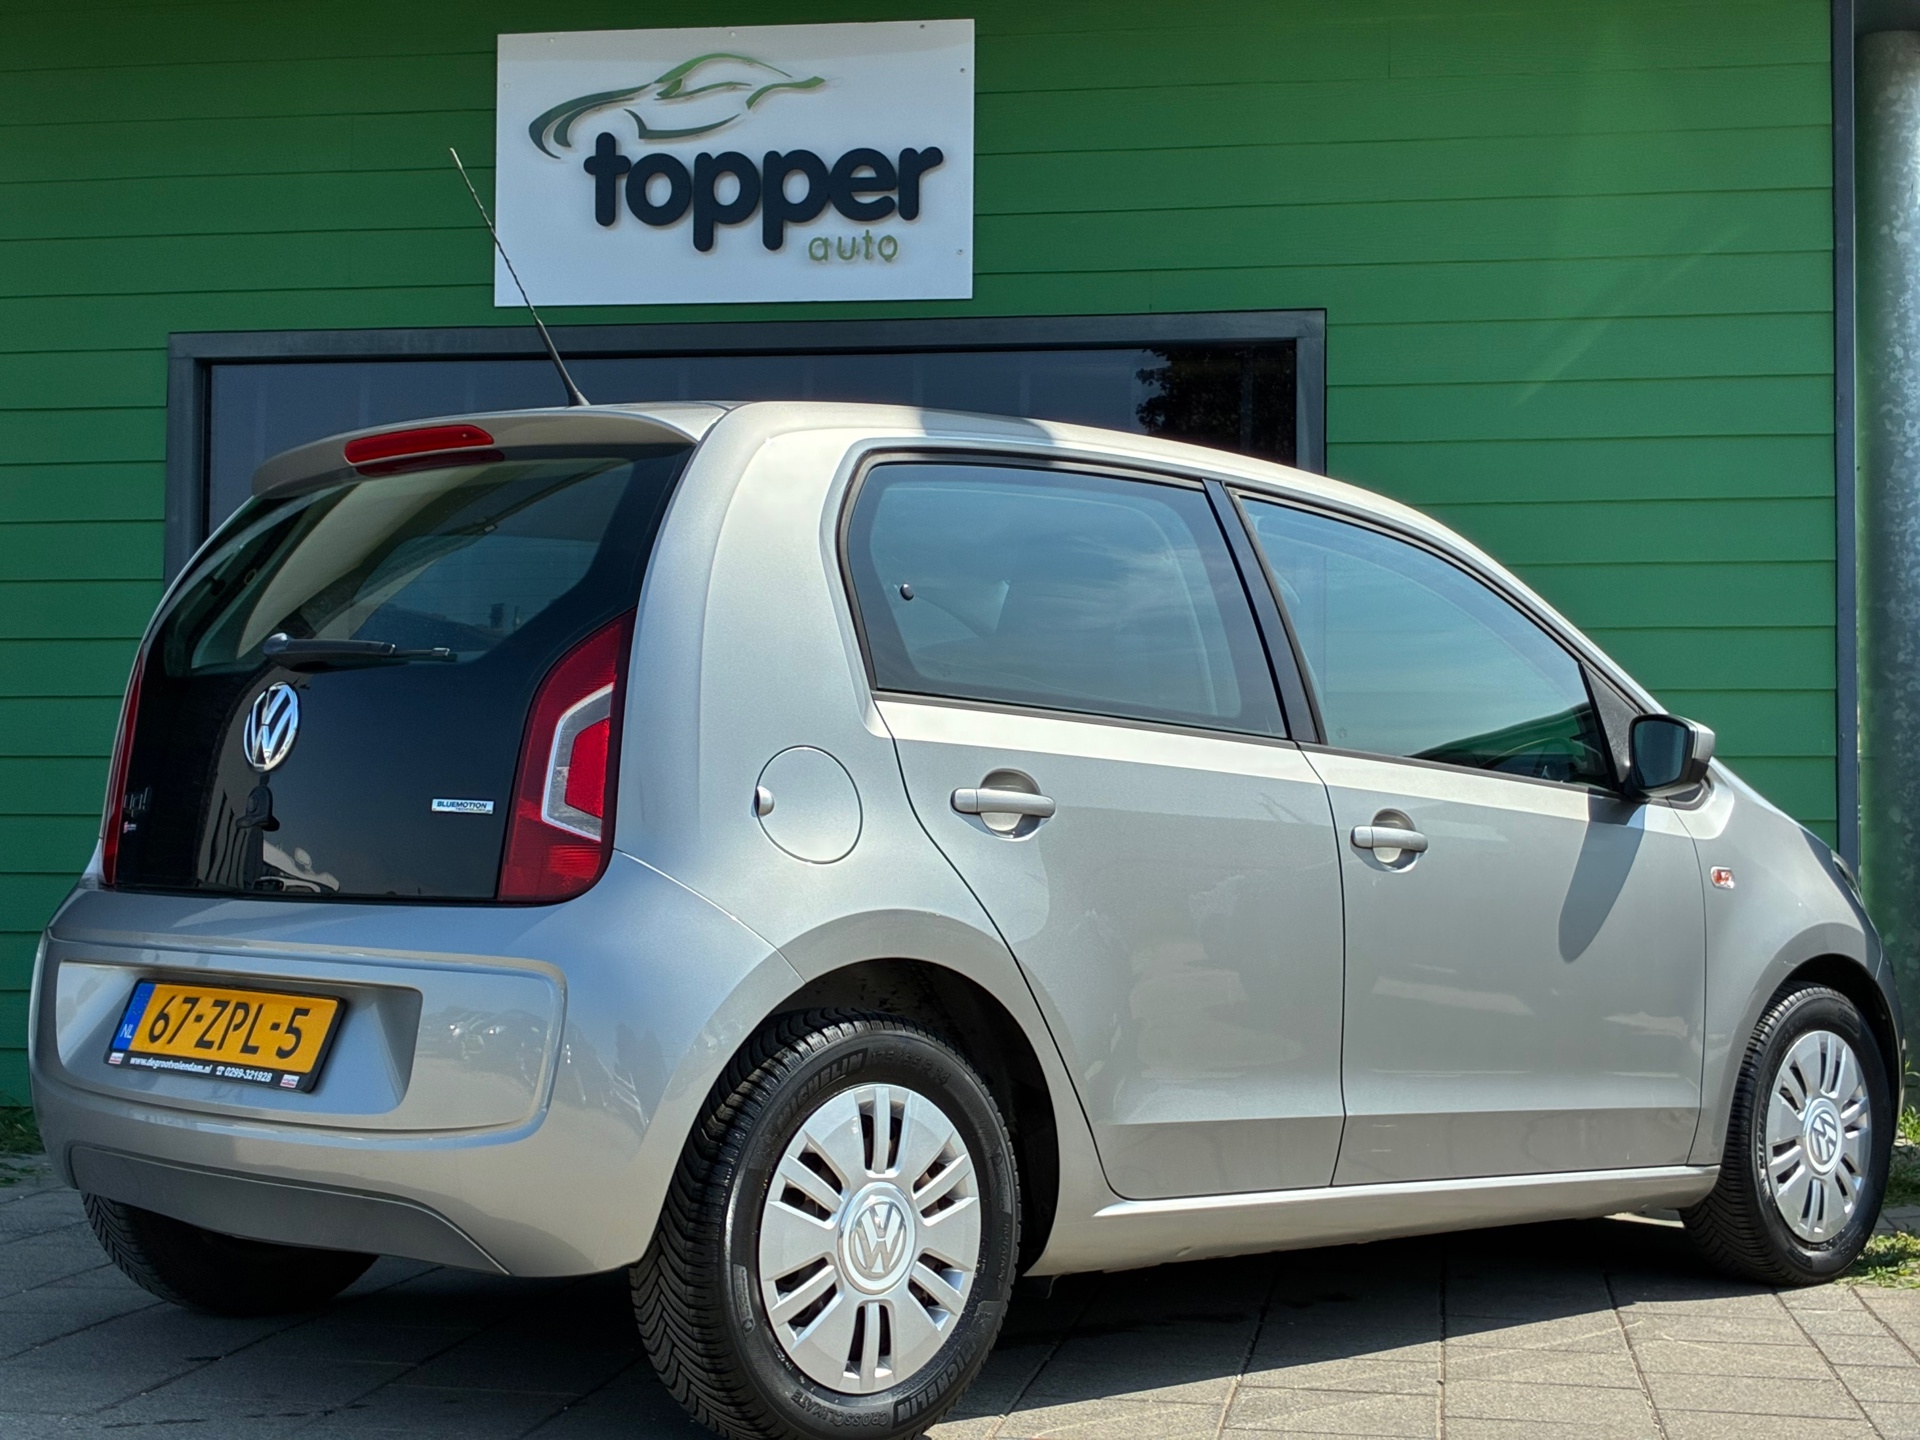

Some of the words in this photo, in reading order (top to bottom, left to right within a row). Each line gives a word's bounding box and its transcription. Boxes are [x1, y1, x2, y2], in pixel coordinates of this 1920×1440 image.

[583, 132, 943, 252] topper
[808, 230, 898, 262] auto
[436, 801, 488, 809] BLUEMOTION
[120, 1024, 132, 1039] NL
[148, 995, 310, 1059] 67-ZPL-5
[130, 1057, 213, 1074] www.degrootvolendam.nl
[224, 1067, 273, 1083] 0299-321928
[776, 1052, 863, 1127] MICHELIN
[897, 1340, 977, 1423] MICHELIN
[791, 1389, 890, 1426] CROSSCLIMATE
